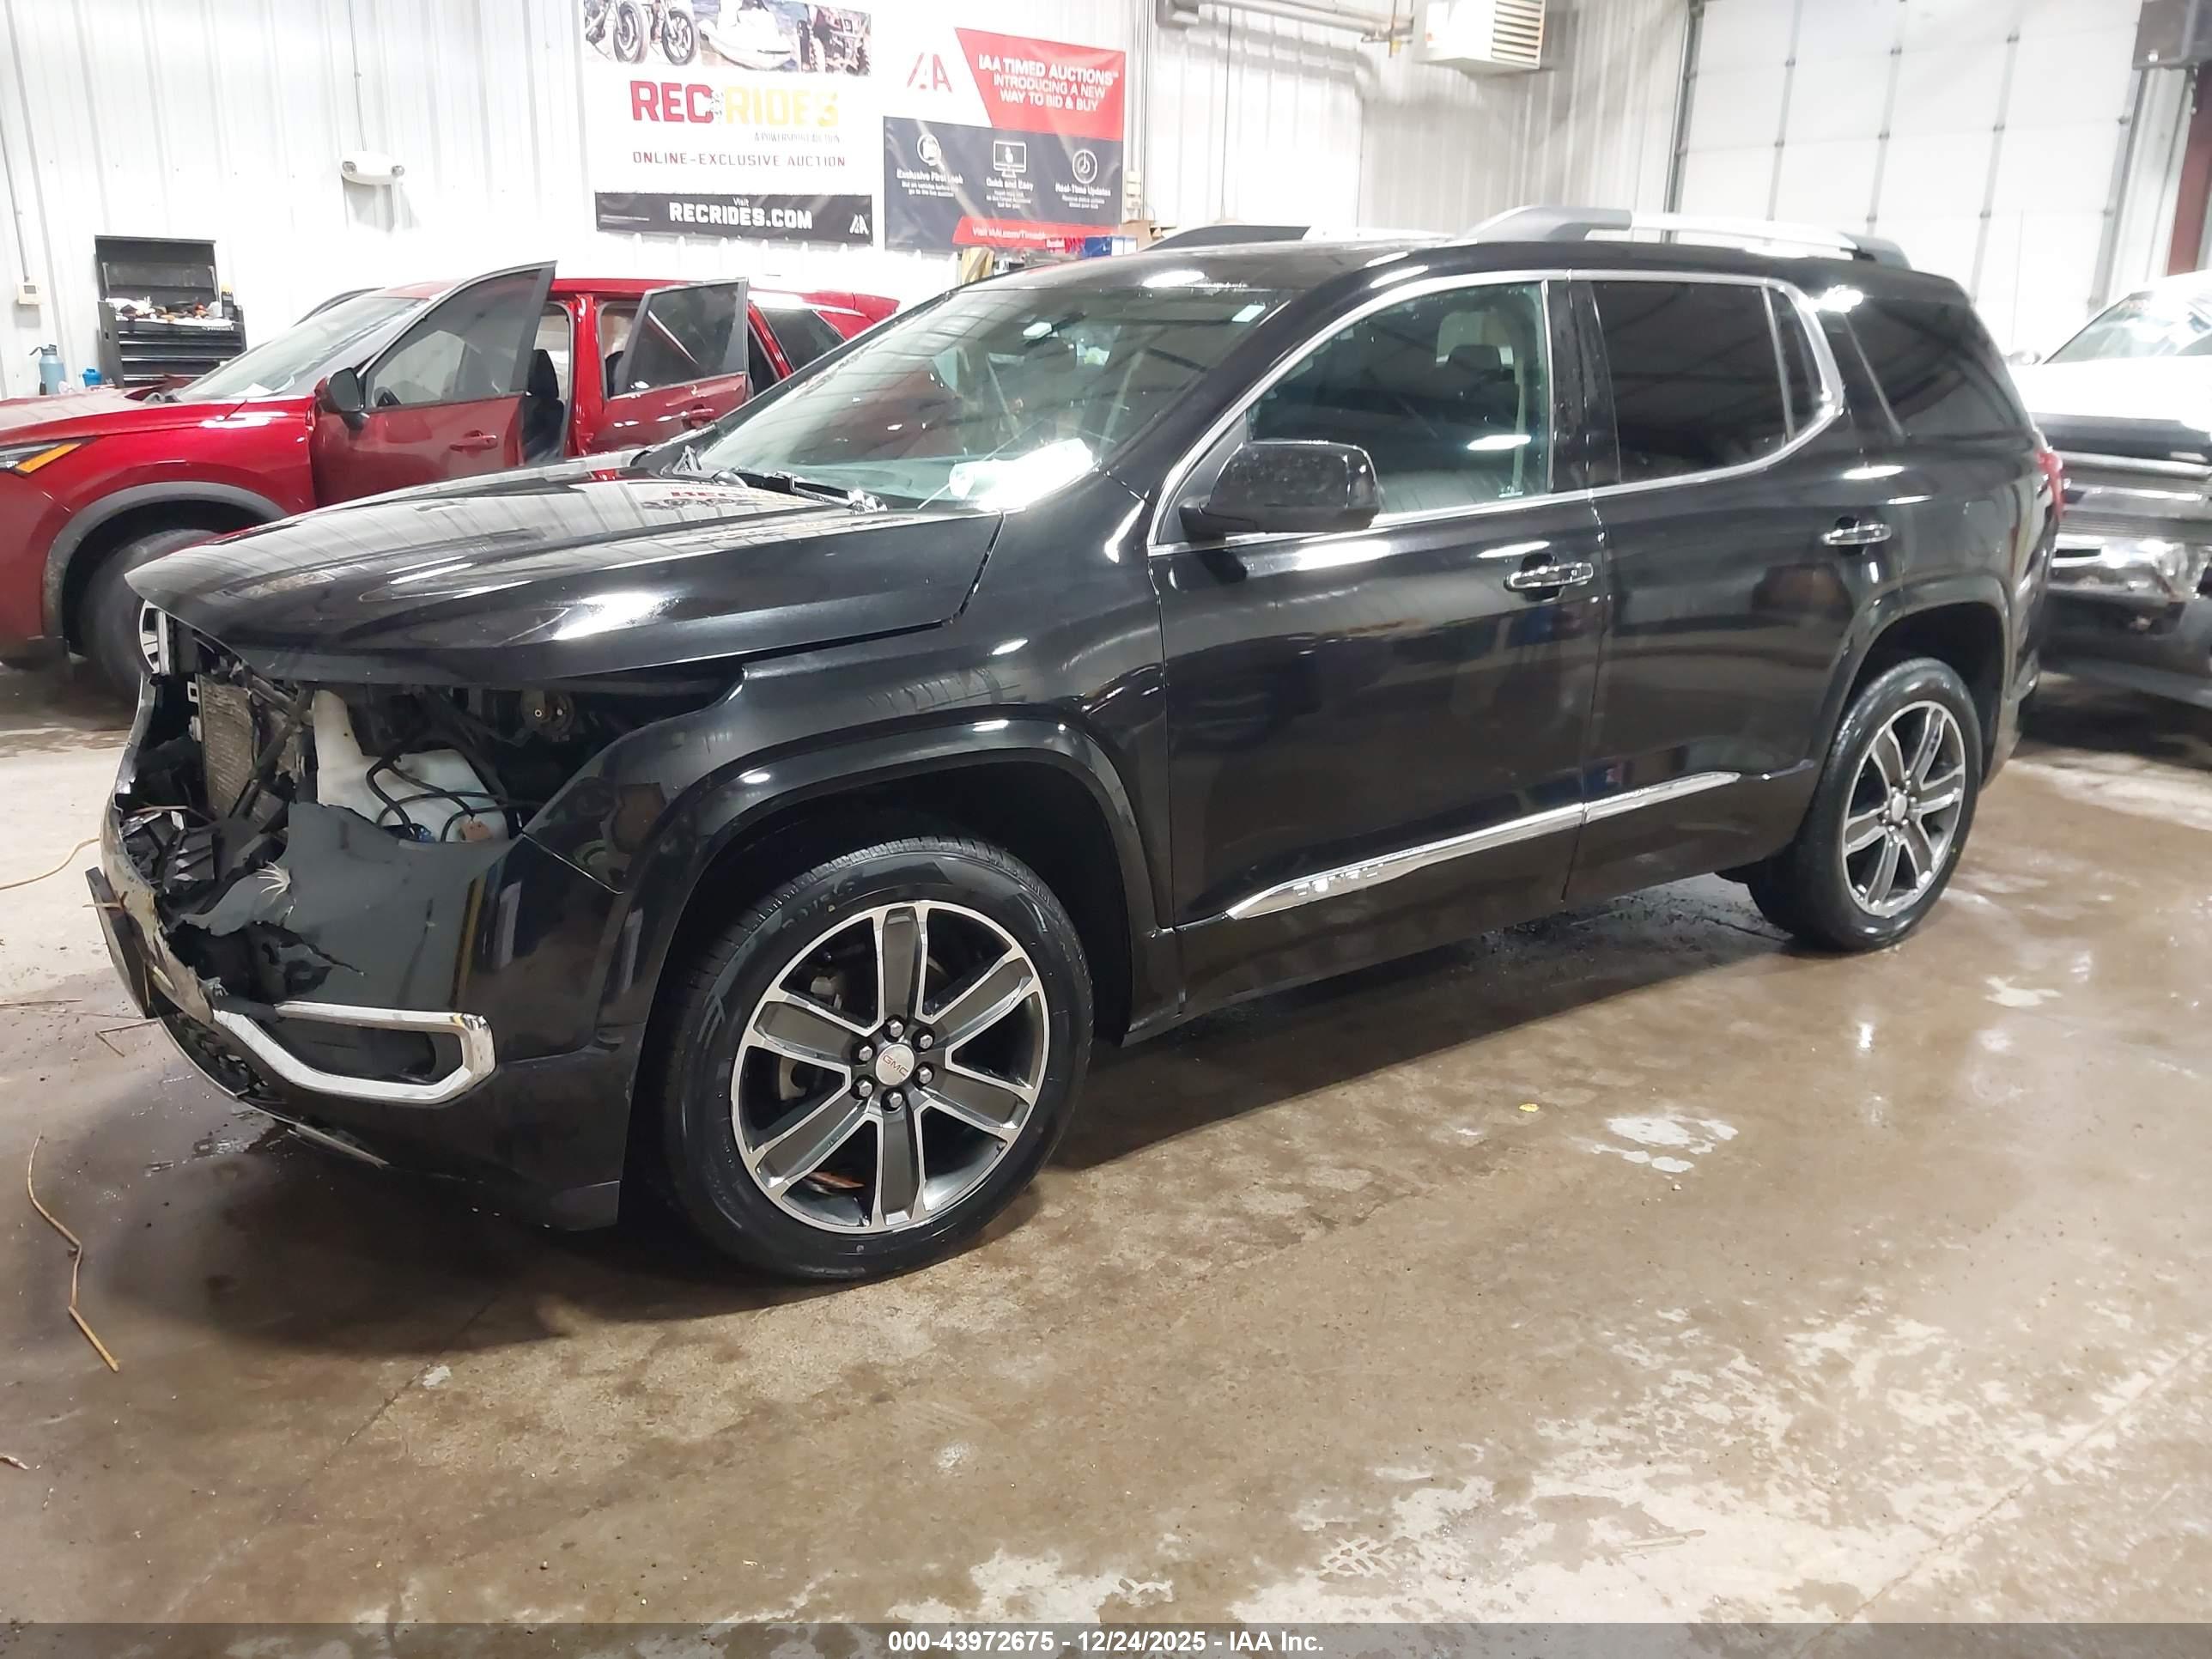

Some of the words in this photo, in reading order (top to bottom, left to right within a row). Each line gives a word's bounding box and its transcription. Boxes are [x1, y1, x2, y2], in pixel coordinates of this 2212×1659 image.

[978, 54, 1001, 71] IAA
[1002, 58, 1046, 77] TIMED
[994, 74, 1067, 94] INTRODUCING
[1069, 83, 1079, 95] A
[1080, 84, 1106, 99] NEW
[630, 81, 714, 124] REC
[725, 86, 838, 127] RIDES
[1000, 89, 1026, 104] WAY
[1029, 93, 1043, 106] TO
[1046, 94, 1063, 108] BID
[1065, 96, 1073, 110] &
[1076, 99, 1099, 112] BUY
[633, 151, 780, 167] ONLINE-EXCLUSIVE
[787, 155, 845, 167] AUCTION
[733, 198, 749, 207] Visit
[669, 202, 812, 229] RECRIDES.COM
[882, 1054, 908, 1077] GMC
